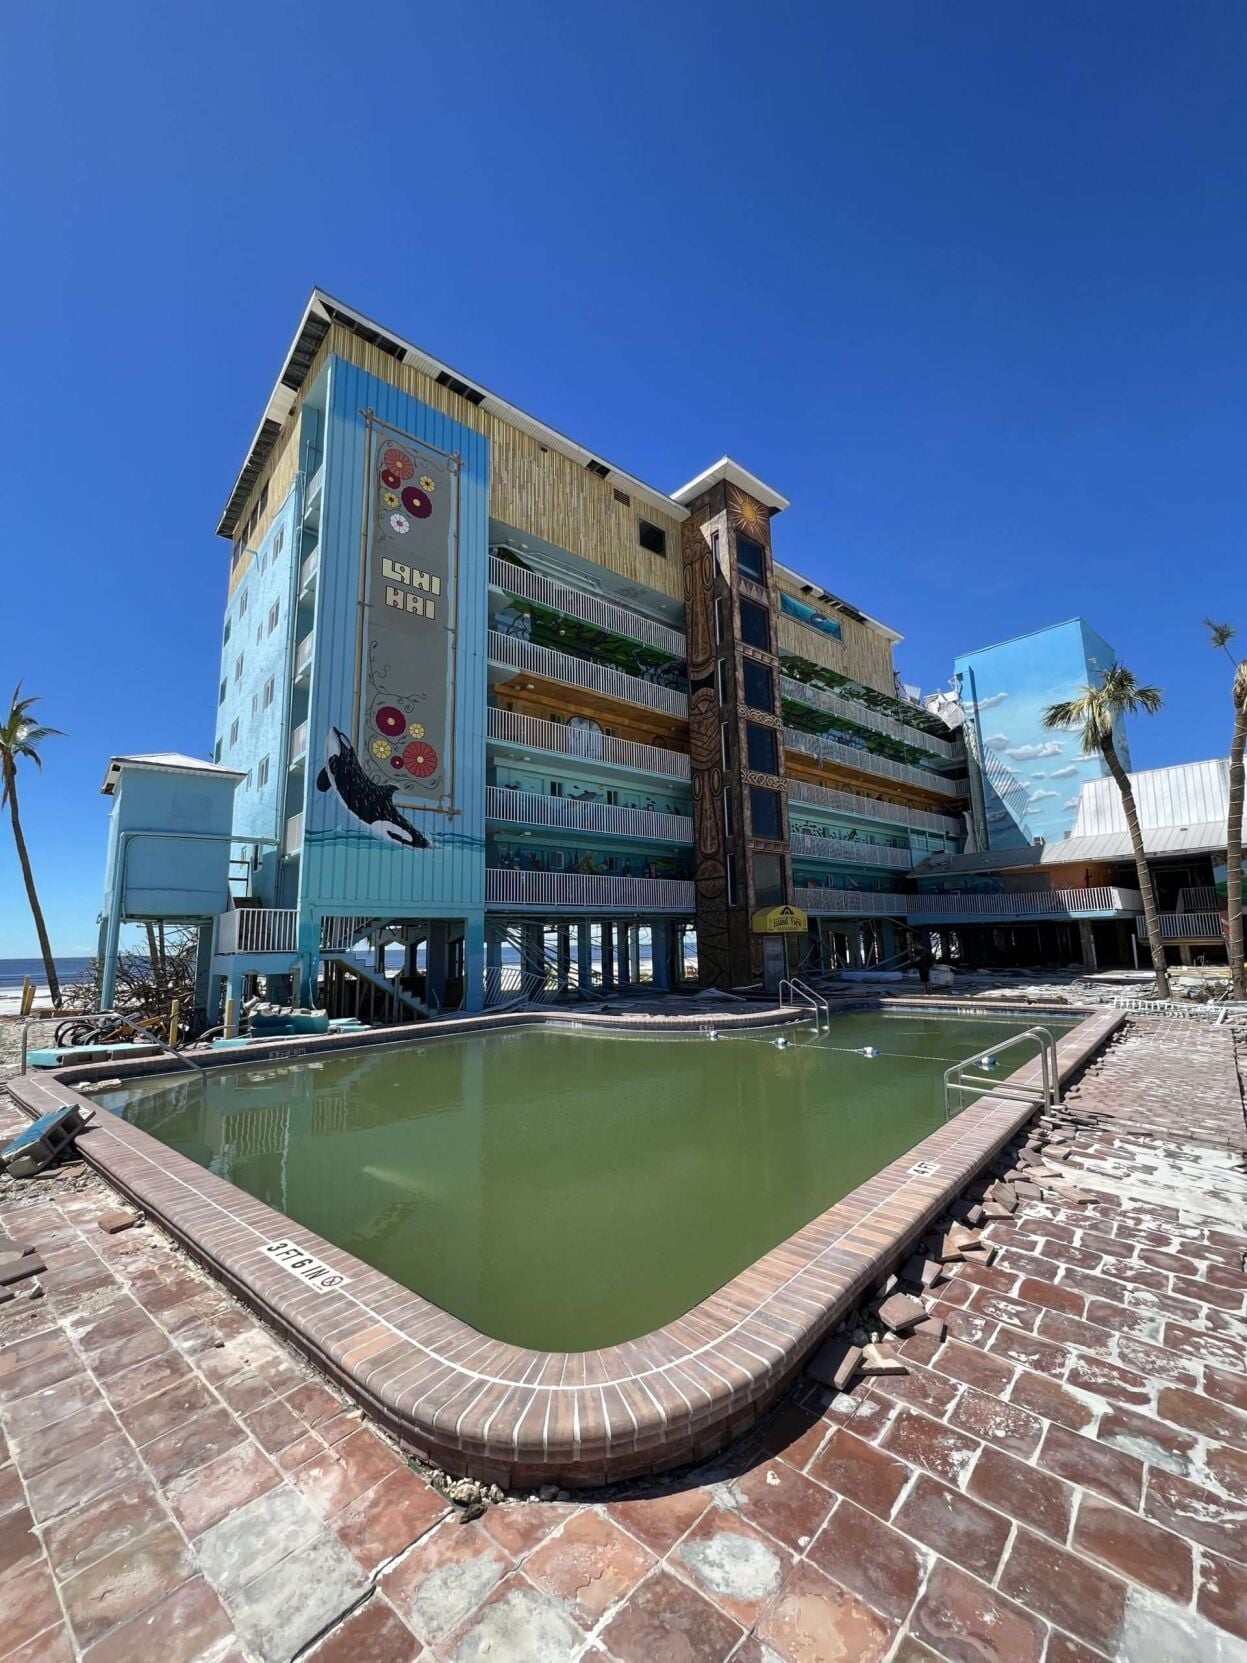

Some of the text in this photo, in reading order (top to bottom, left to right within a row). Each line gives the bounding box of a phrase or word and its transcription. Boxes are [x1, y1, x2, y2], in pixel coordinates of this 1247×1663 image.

[266, 1242, 330, 1280] 3 FT 6 IN
